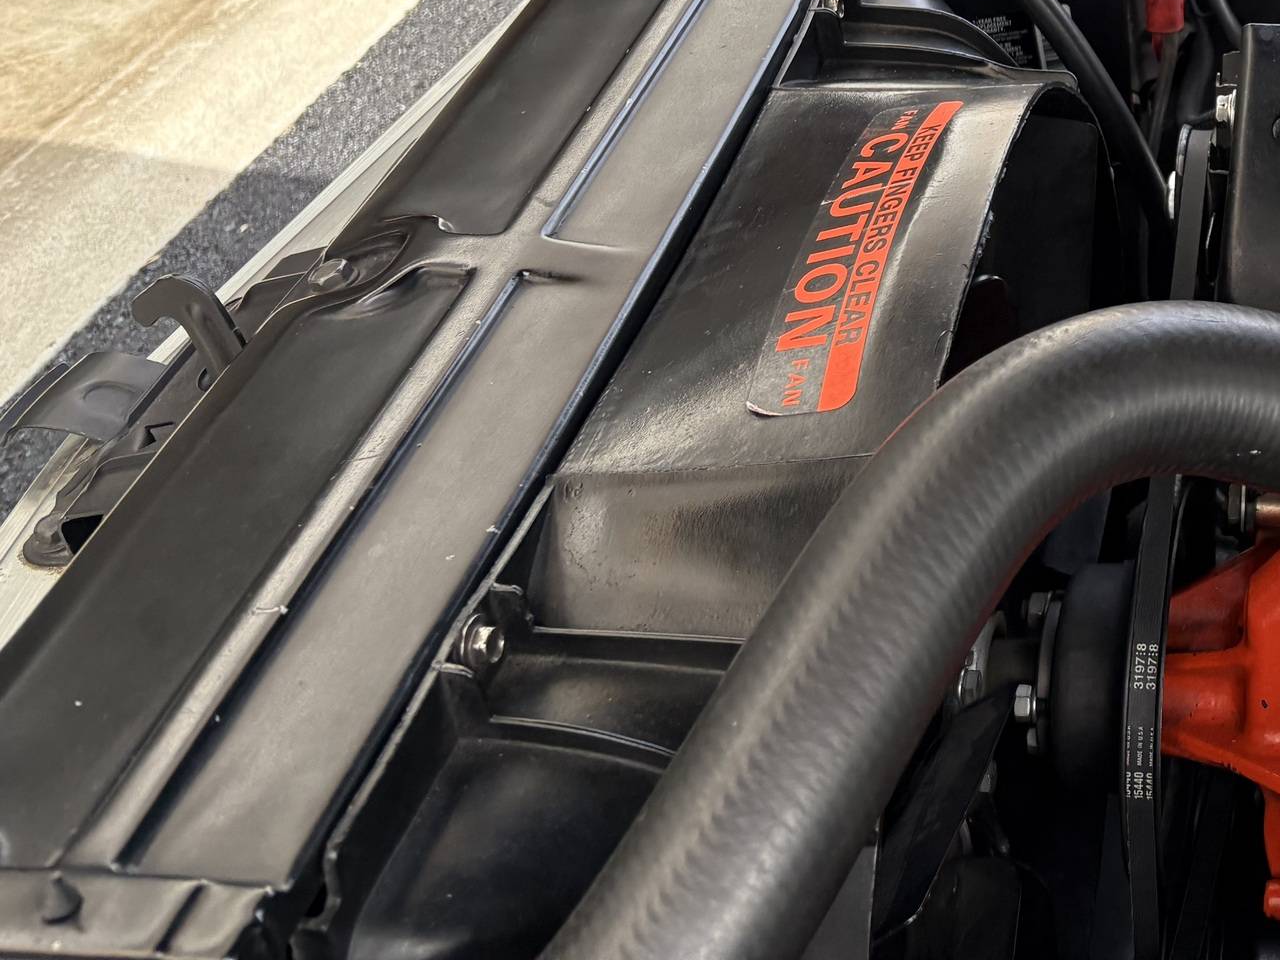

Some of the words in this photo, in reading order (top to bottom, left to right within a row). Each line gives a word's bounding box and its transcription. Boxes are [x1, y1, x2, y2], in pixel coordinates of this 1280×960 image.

[892, 109, 919, 131] FAN
[905, 123, 942, 162] KEEP
[862, 167, 916, 253] FINGERS
[775, 132, 909, 352] CAUTION
[834, 259, 880, 346] CLEAR
[782, 358, 808, 407] FAN
[1133, 771, 1144, 800] 15440
